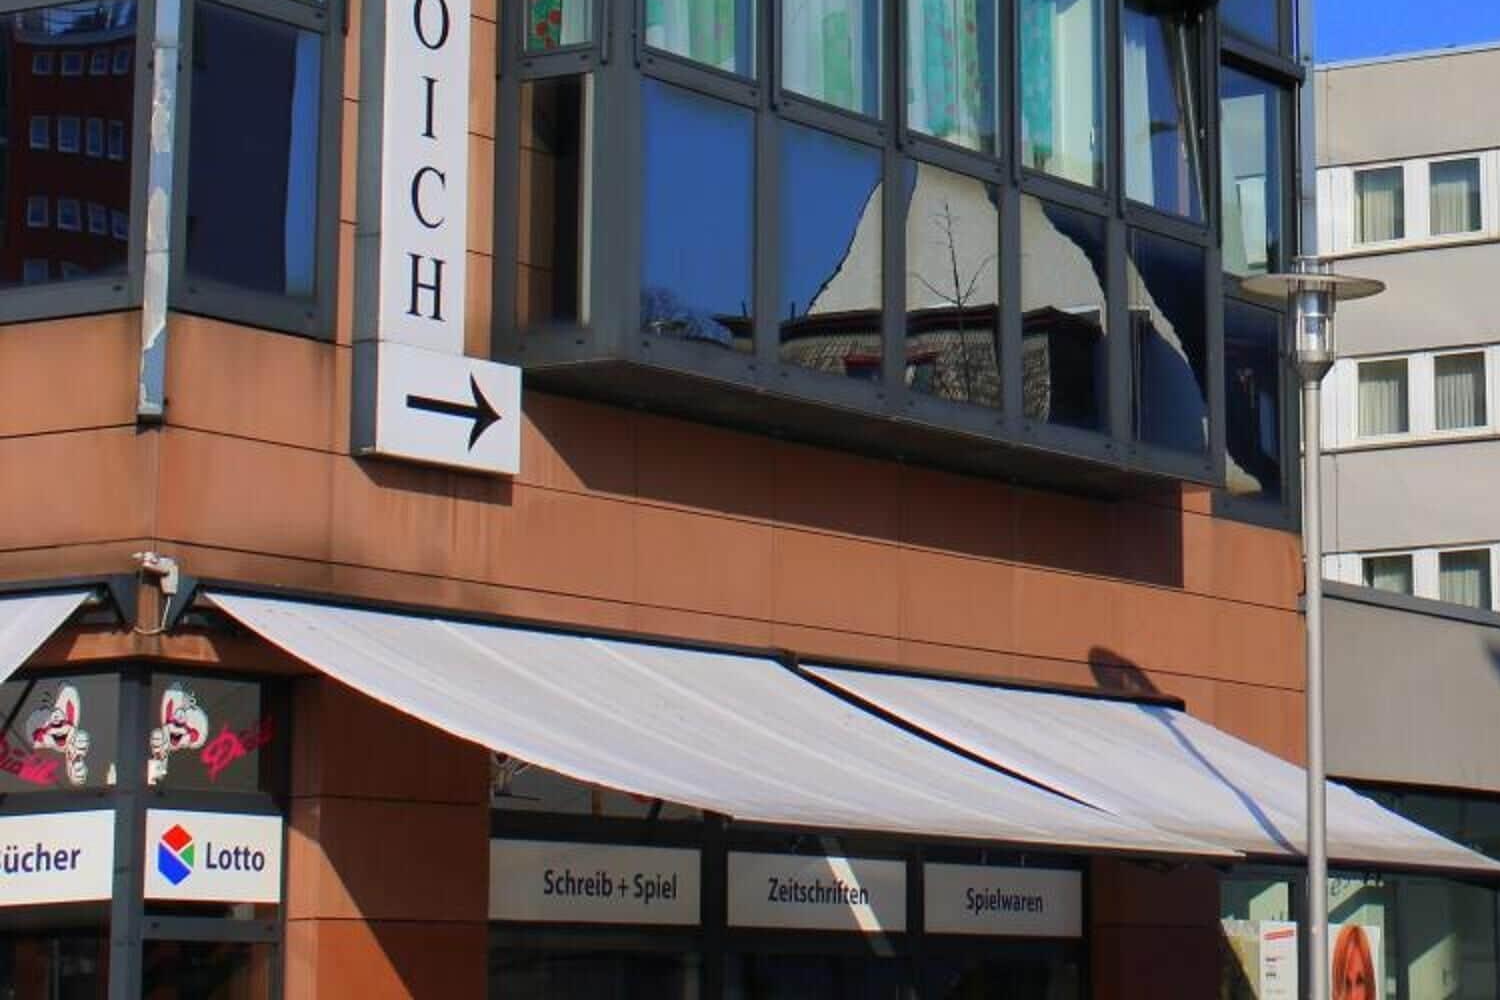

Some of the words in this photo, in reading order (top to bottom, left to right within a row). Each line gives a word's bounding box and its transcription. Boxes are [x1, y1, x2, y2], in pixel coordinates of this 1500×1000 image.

[0, 843, 81, 874] ücher
[206, 841, 265, 871] Lotto
[543, 869, 613, 899] Schreib
[617, 879, 629, 896] +
[633, 873, 677, 901] Spiel
[768, 876, 869, 906] Zeitschriften
[966, 887, 1044, 914] Spielwaren
